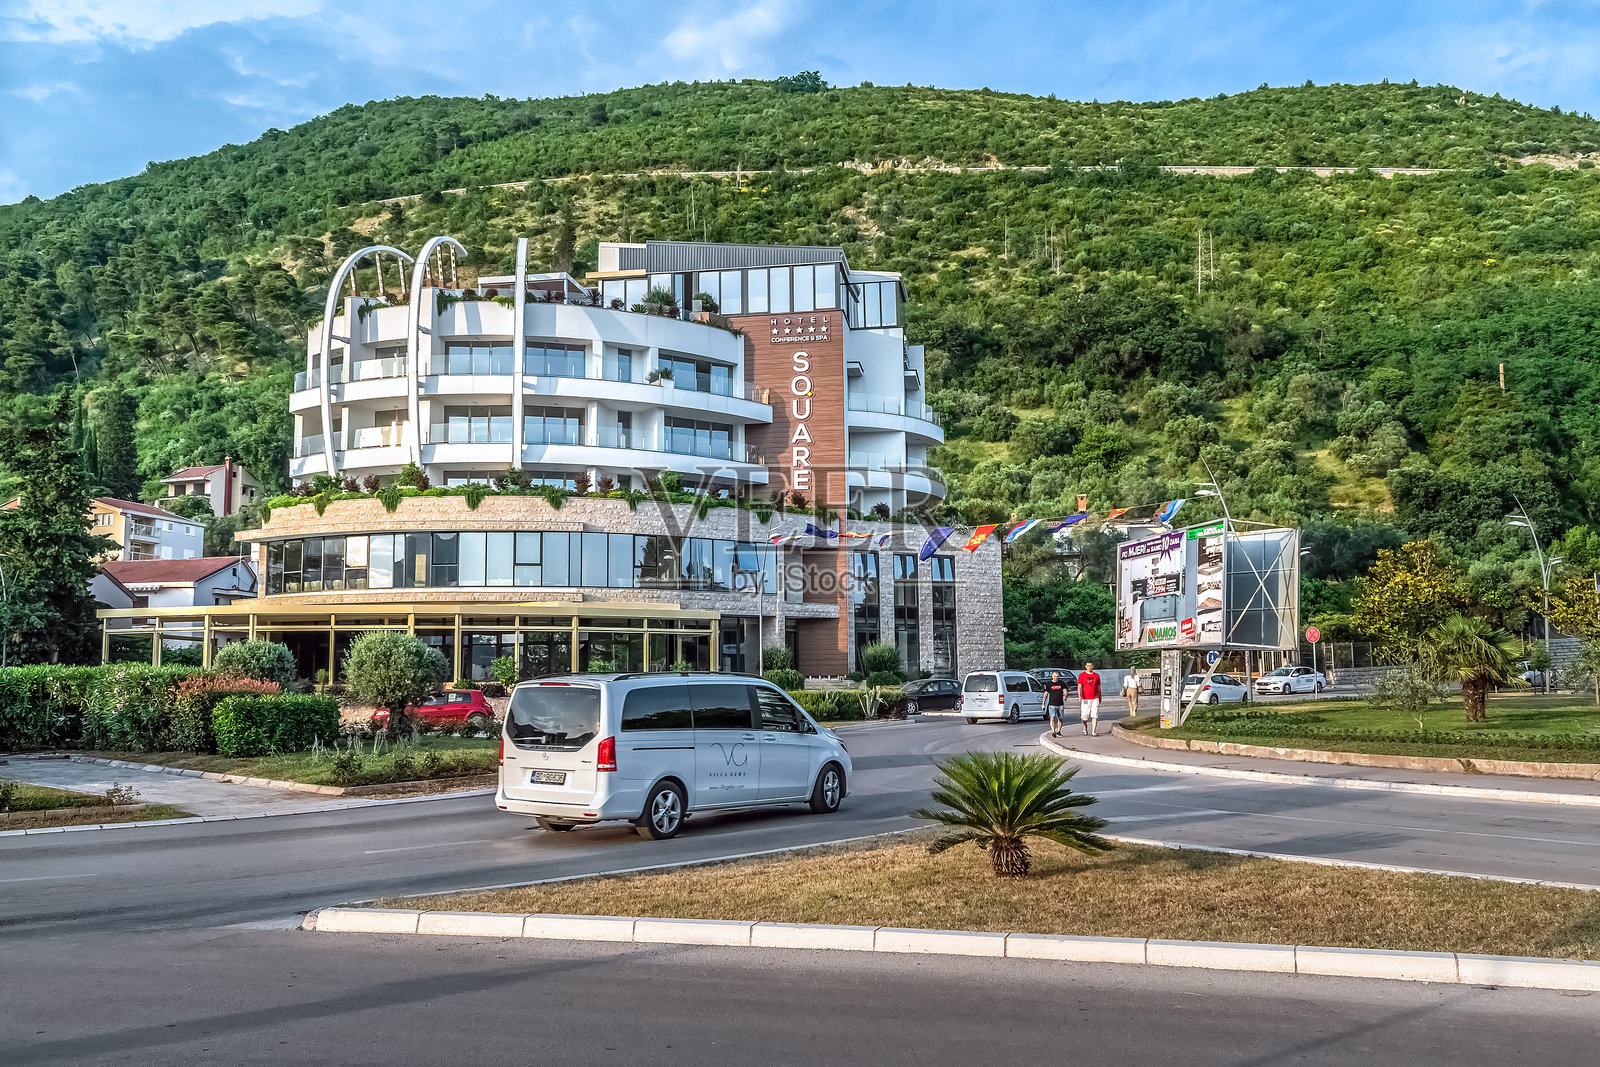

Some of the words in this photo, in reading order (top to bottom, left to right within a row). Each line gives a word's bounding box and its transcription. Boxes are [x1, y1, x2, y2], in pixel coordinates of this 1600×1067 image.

[771, 316, 828, 326] HOTEL
[791, 351, 812, 490] SQUARE
[1162, 536, 1170, 551] 10
